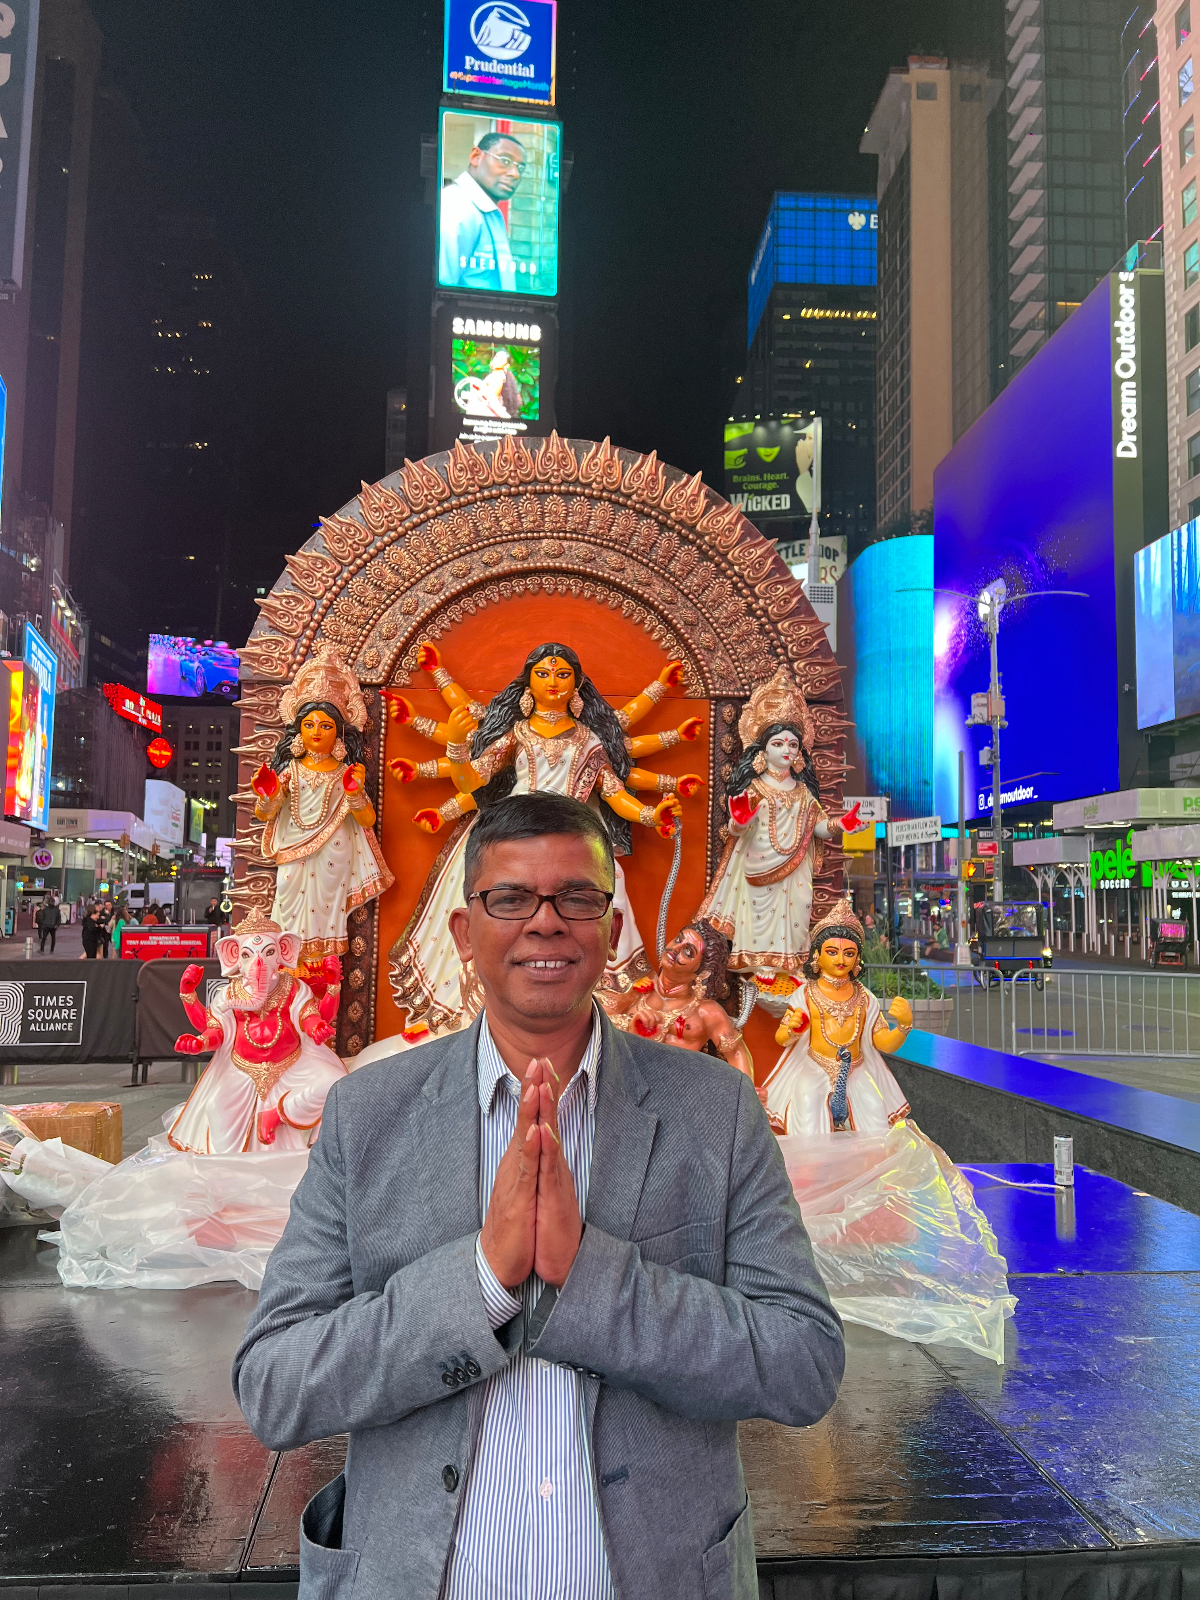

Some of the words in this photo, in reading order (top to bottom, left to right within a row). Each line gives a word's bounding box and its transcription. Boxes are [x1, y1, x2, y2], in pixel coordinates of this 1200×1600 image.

[464, 55, 535, 78] Prudential
[452, 317, 541, 341] SAMSUNG
[1114, 271, 1137, 379] Outdoors
[1116, 381, 1137, 458] Dream
[1100, 879, 1130, 889] SOCCER
[33, 995, 74, 1007] TIMES
[27, 1008, 78, 1021] SQUARE
[29, 1022, 74, 1032] ALLIANCE
